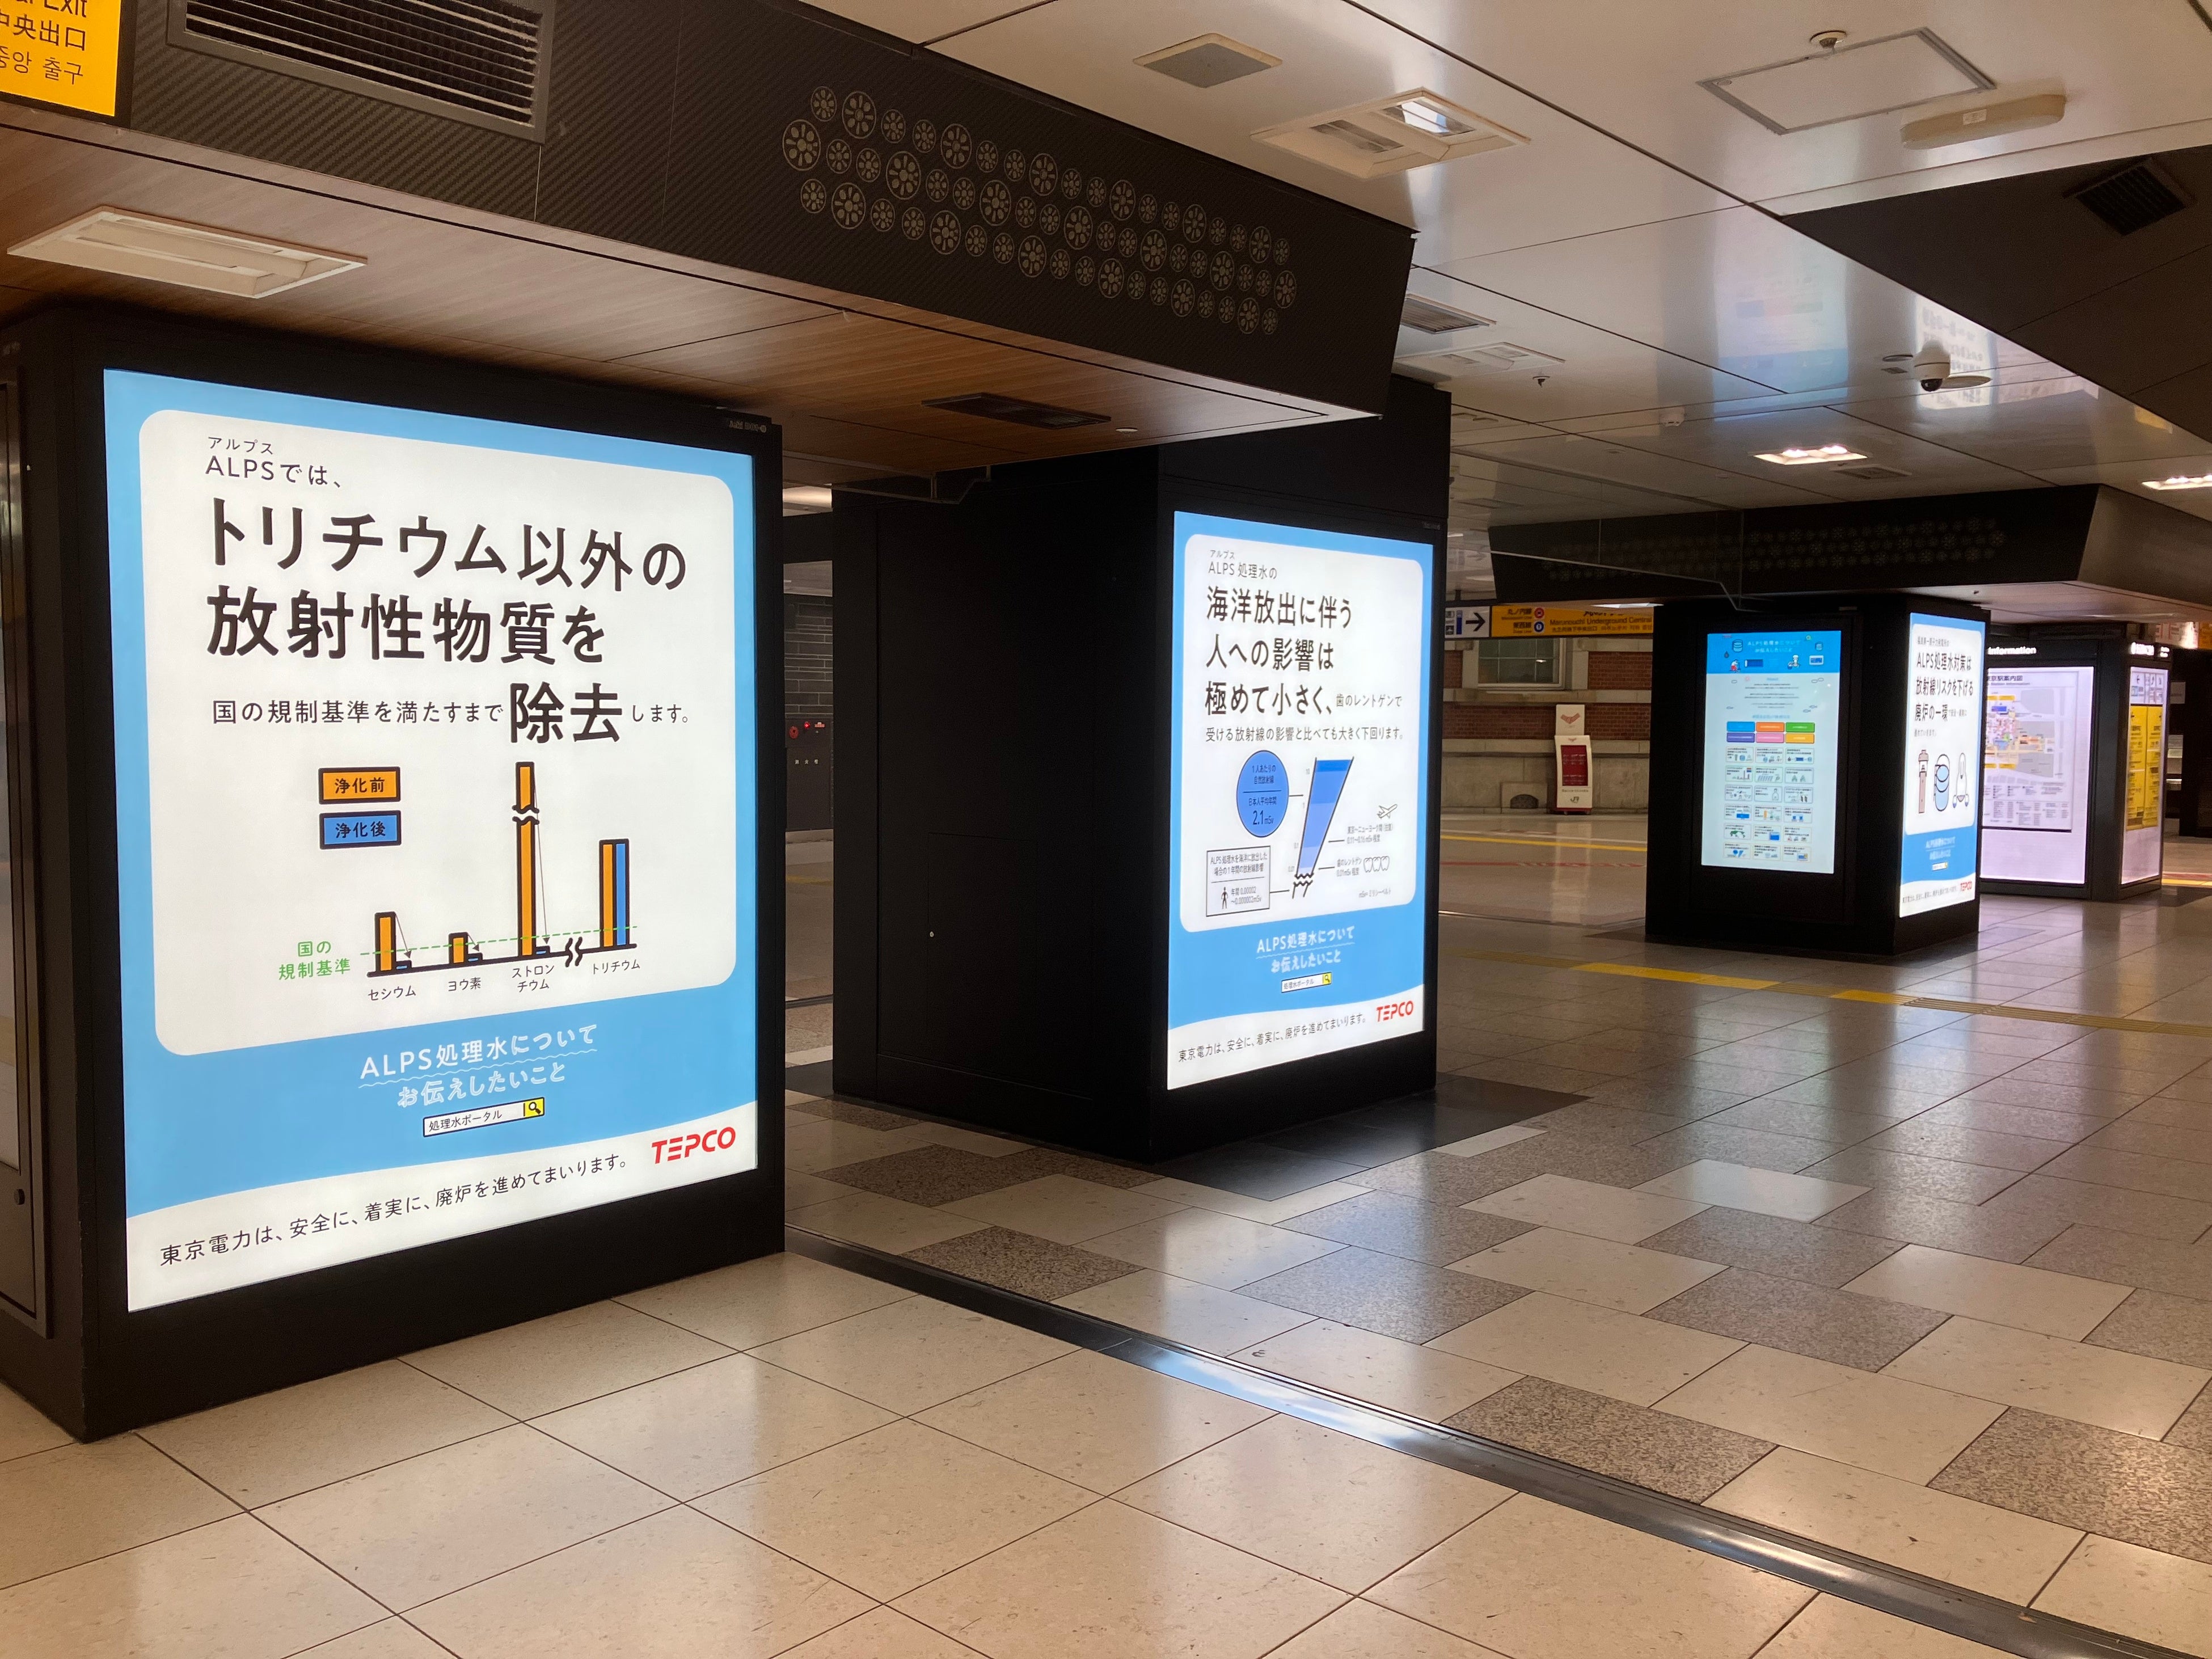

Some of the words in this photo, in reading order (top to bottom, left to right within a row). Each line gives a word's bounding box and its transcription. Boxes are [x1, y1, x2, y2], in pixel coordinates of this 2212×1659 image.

[43, 57, 83, 85] 출구
[208, 436, 273, 455] アルプス
[205, 455, 342, 489] ALPSでは、
[212, 497, 686, 591] トリチウム以外の
[1206, 585, 1352, 628] 海洋放出に伴う
[206, 584, 605, 665] 放射性物質を
[1205, 634, 1335, 672] 人への影響は
[334, 778, 385, 794] 浄化前
[335, 821, 387, 839] 浄化後
[297, 939, 332, 957] 国の
[1256, 926, 1355, 953] ALPS処理水について
[278, 958, 352, 981] 規制基準
[511, 962, 556, 980] ストロン
[591, 958, 641, 977] トリチウム
[1270, 949, 1342, 974] お伝えしたいこと
[367, 984, 417, 1002] セシウム
[447, 976, 482, 993] ヨウ素
[516, 978, 551, 994] チウム
[1376, 1000, 1414, 1023] TEPCO
[360, 1023, 598, 1080] ALPS処理水について
[397, 1061, 566, 1109] お伝えしたいこと
[428, 1108, 504, 1133] 処理水ポータル
[651, 1126, 736, 1164] TEPCO
[159, 1153, 628, 1268] 東京電力は、安全に、着実に、廃炉を進めてまいります。
